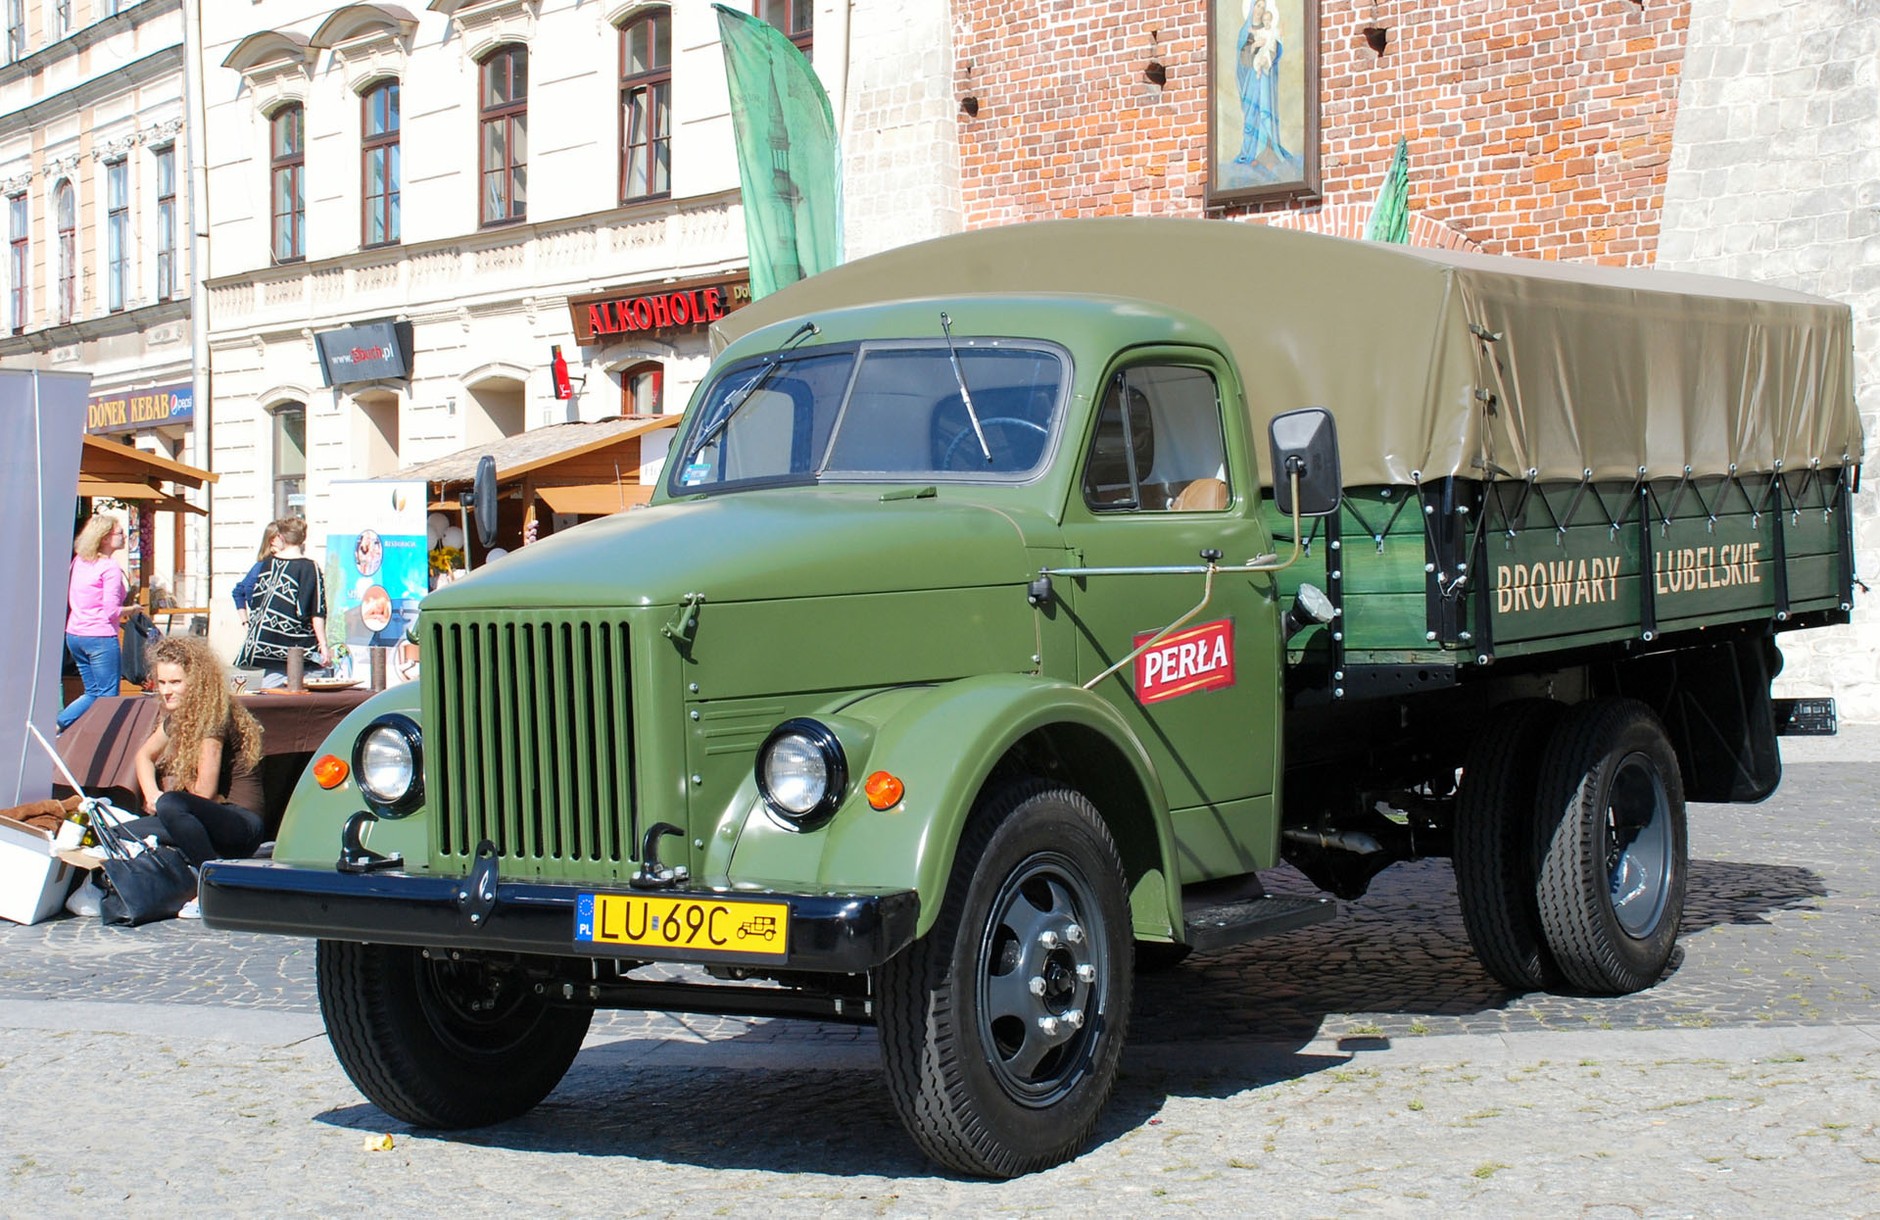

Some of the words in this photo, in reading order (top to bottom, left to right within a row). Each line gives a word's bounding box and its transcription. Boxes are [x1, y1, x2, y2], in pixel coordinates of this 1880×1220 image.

[589, 287, 724, 337] ALKOHOLE
[88, 397, 127, 429] DÖNER
[130, 393, 170, 423] KEBAB
[177, 395, 193, 411] pepsi
[1497, 556, 1620, 614] BROWARY
[1655, 542, 1761, 595] LUBELSKIE
[1143, 634, 1228, 688] PERŁA
[579, 923, 592, 936] PL
[601, 899, 648, 941] LU
[662, 903, 731, 946] 69C
